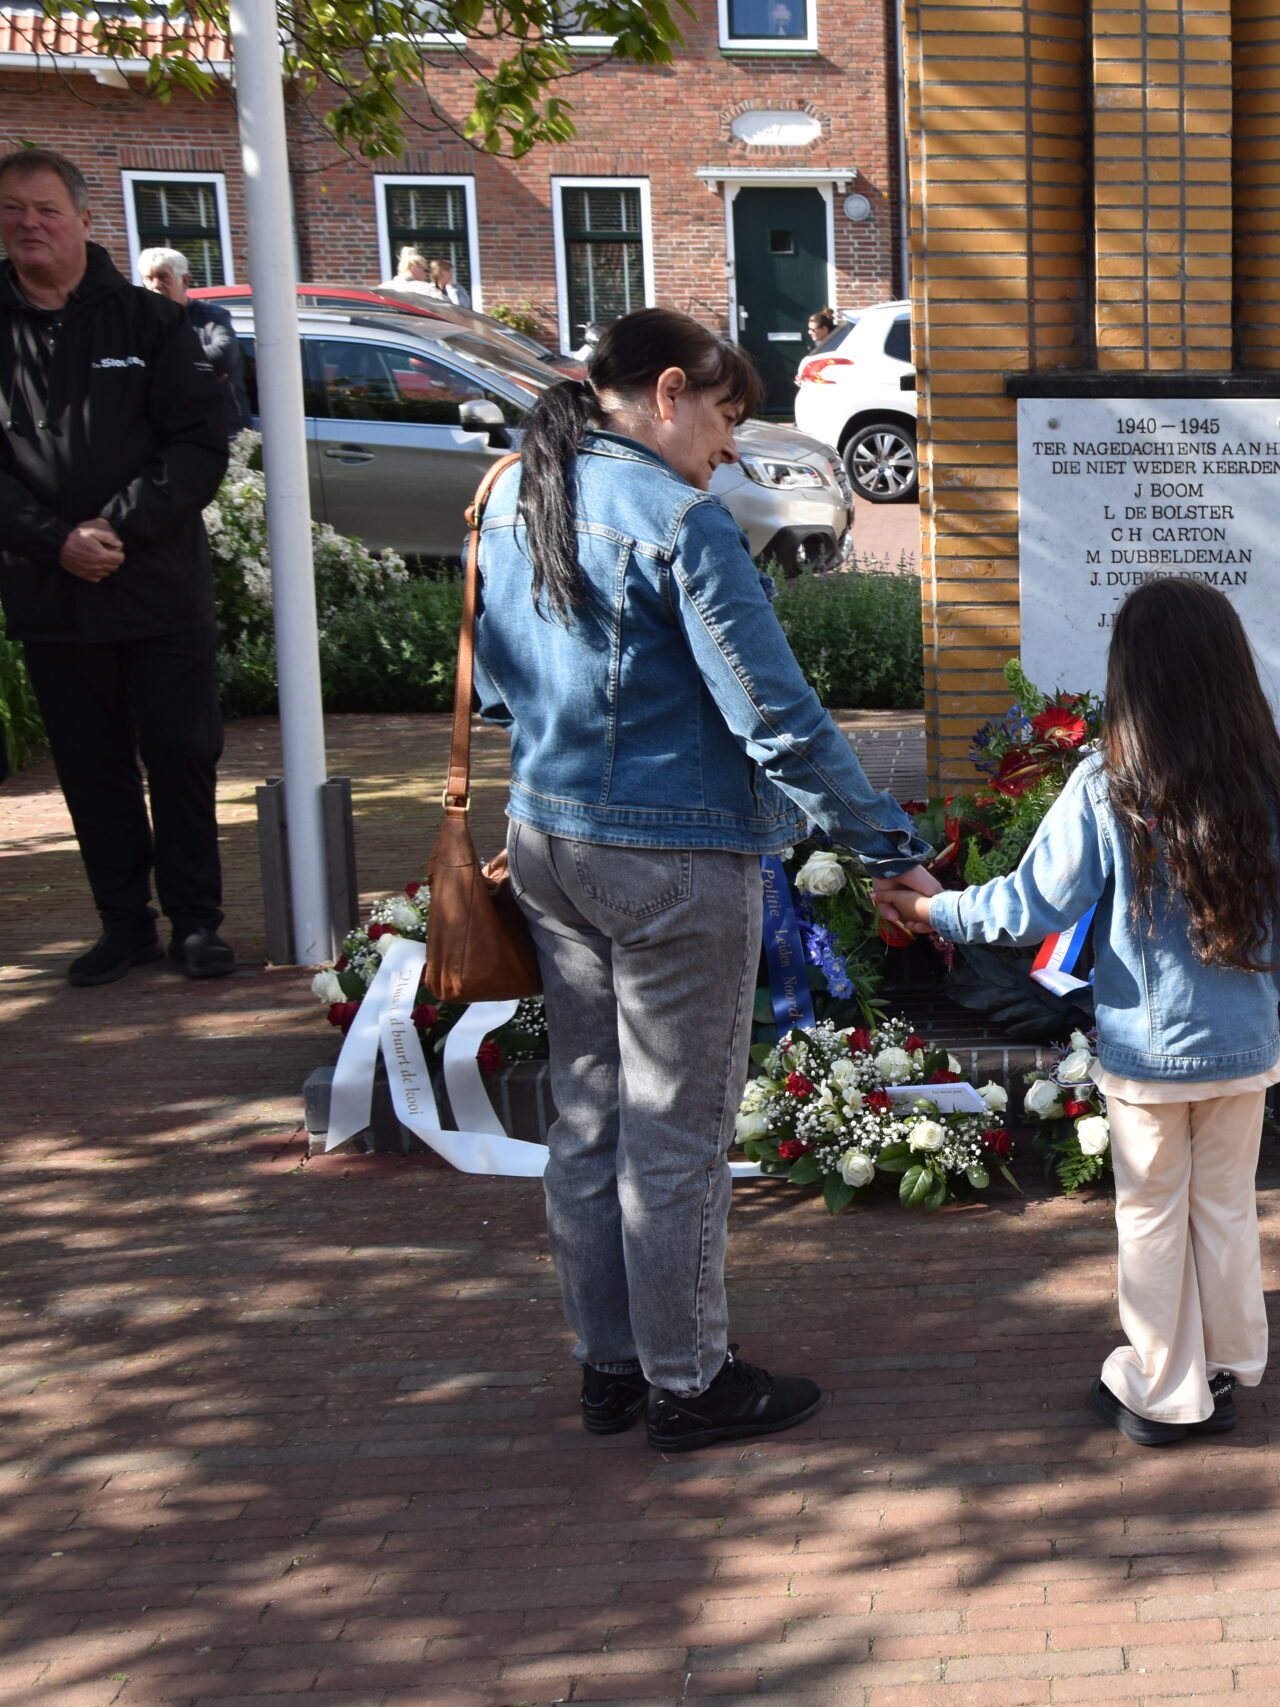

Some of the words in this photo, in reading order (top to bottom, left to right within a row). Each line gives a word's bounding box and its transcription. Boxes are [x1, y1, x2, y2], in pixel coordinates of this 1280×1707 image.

[1116, 417, 1157, 434] 1940
[1180, 417, 1221, 434] 1945
[1032, 441, 1067, 456] TER
[1072, 441, 1217, 456] NAGEDACHTENIS
[1221, 441, 1262, 456] AAN
[1051, 460, 1081, 475] DIE
[1085, 460, 1128, 475] NIET
[1132, 460, 1198, 475] WEDER
[1133, 482, 1143, 498] J
[1149, 482, 1205, 498] BOOM
[1103, 505, 1116, 520] L
[1124, 505, 1147, 520] DE
[1150, 504, 1235, 520] BOLSTER
[1151, 526, 1227, 542] CARTON
[1084, 549, 1102, 564] M
[1110, 548, 1253, 564] DUBBELDEMAN
[1089, 571, 1102, 586] J.
[761, 868, 783, 917] Politie
[774, 928, 794, 968] Leiden
[782, 975, 804, 1018] Noord
[391, 1030, 411, 1065] buurt
[400, 1071, 417, 1084] de
[404, 1086, 424, 1116] kooi
